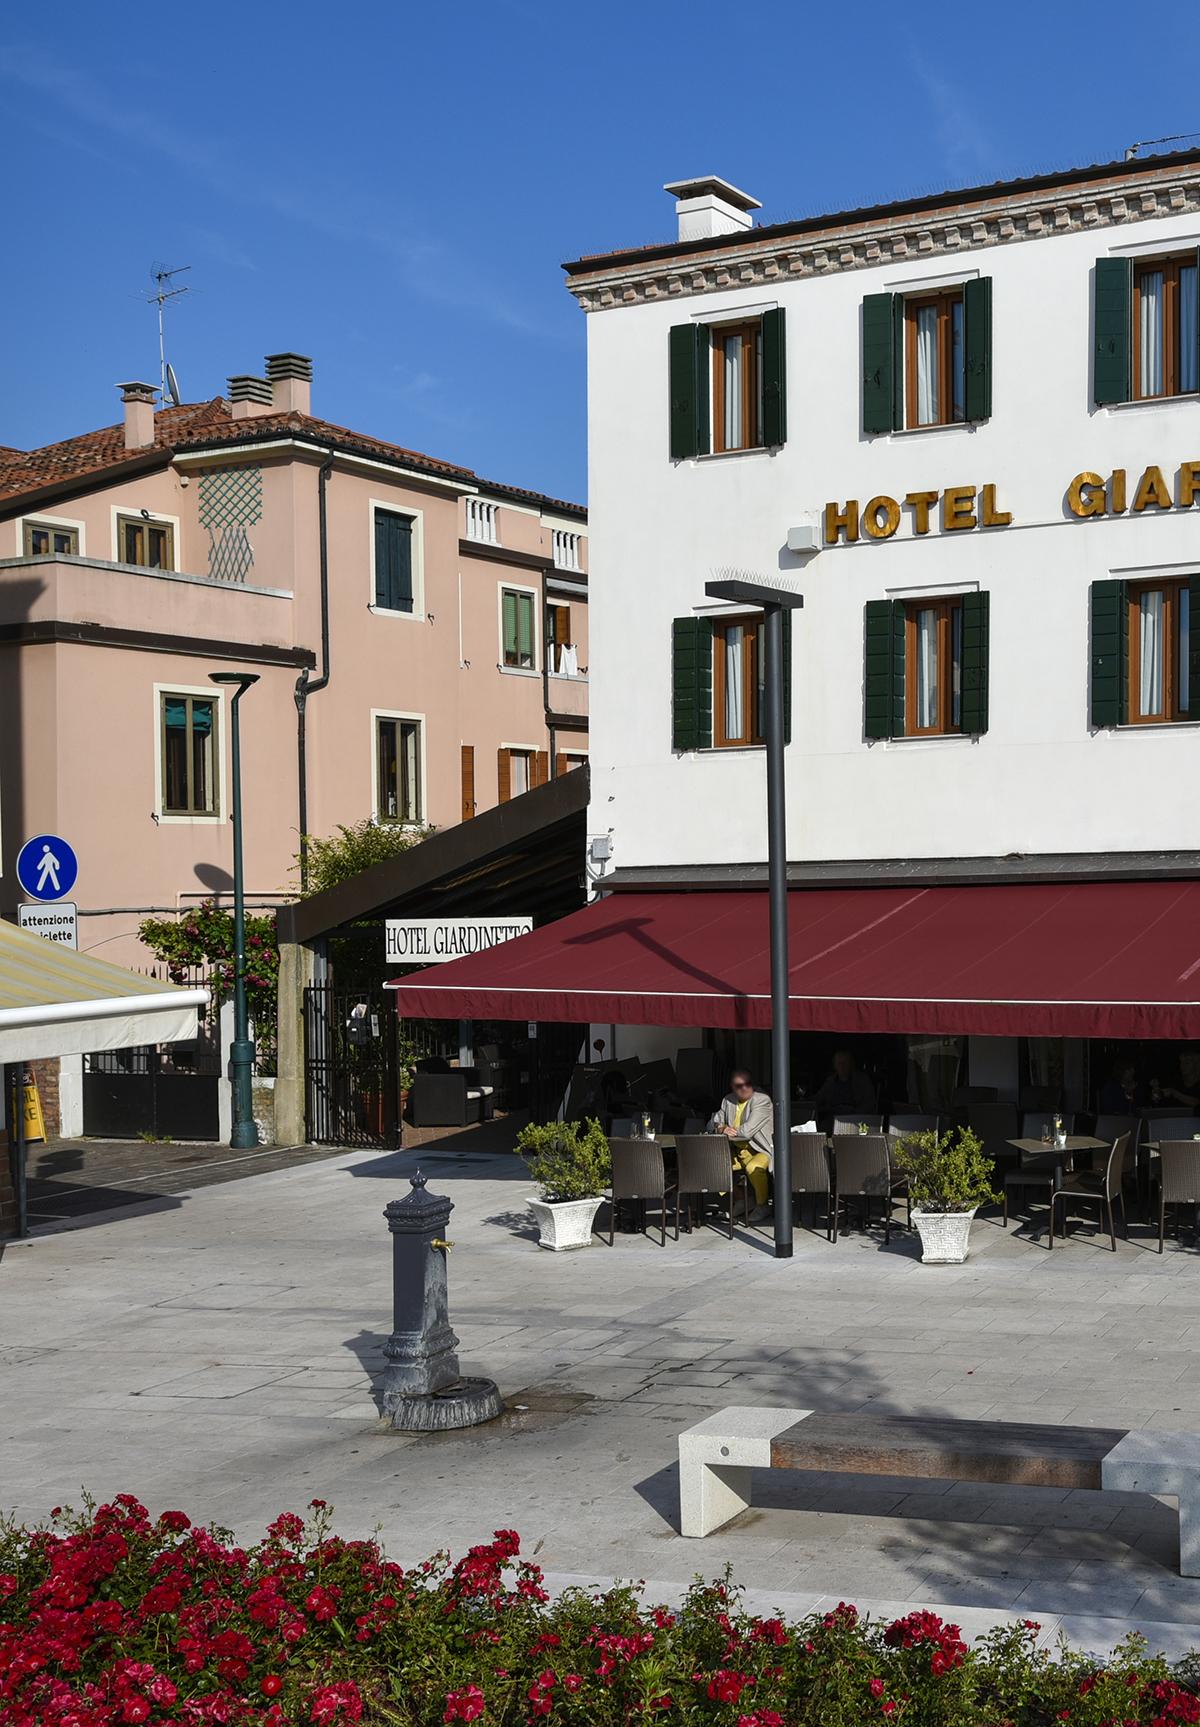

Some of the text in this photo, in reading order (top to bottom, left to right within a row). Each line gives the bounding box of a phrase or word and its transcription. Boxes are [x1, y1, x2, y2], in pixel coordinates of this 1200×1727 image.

[825, 483, 1013, 544] HOTEL
[22, 914, 75, 927] attenzione
[386, 927, 431, 954] HOTEL
